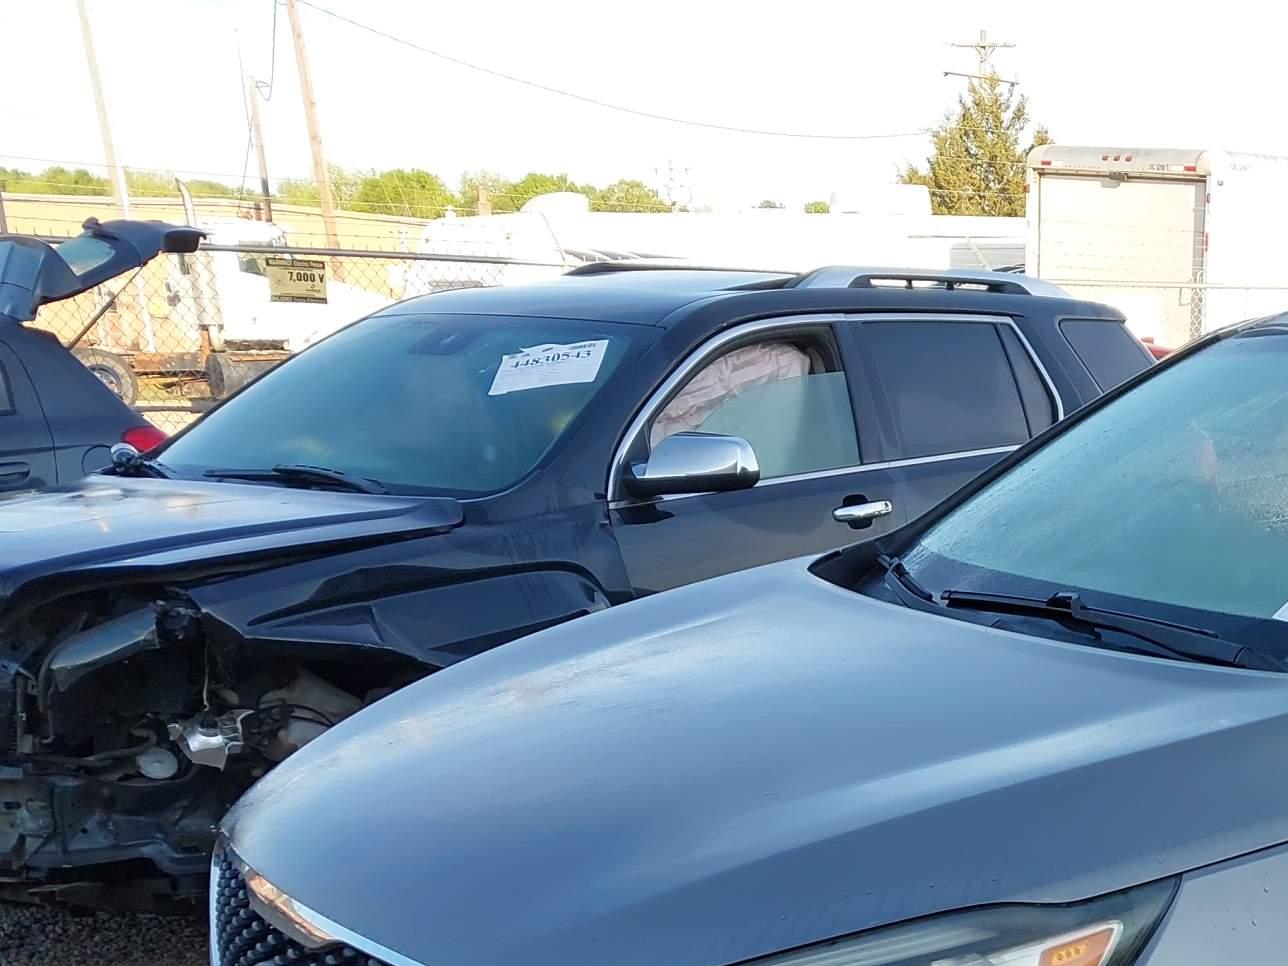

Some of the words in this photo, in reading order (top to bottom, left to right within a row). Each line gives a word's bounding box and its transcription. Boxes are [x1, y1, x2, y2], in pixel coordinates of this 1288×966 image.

[287, 271, 316, 283] 7,000
[318, 273, 325, 283] V
[510, 350, 591, 368] 44830543
